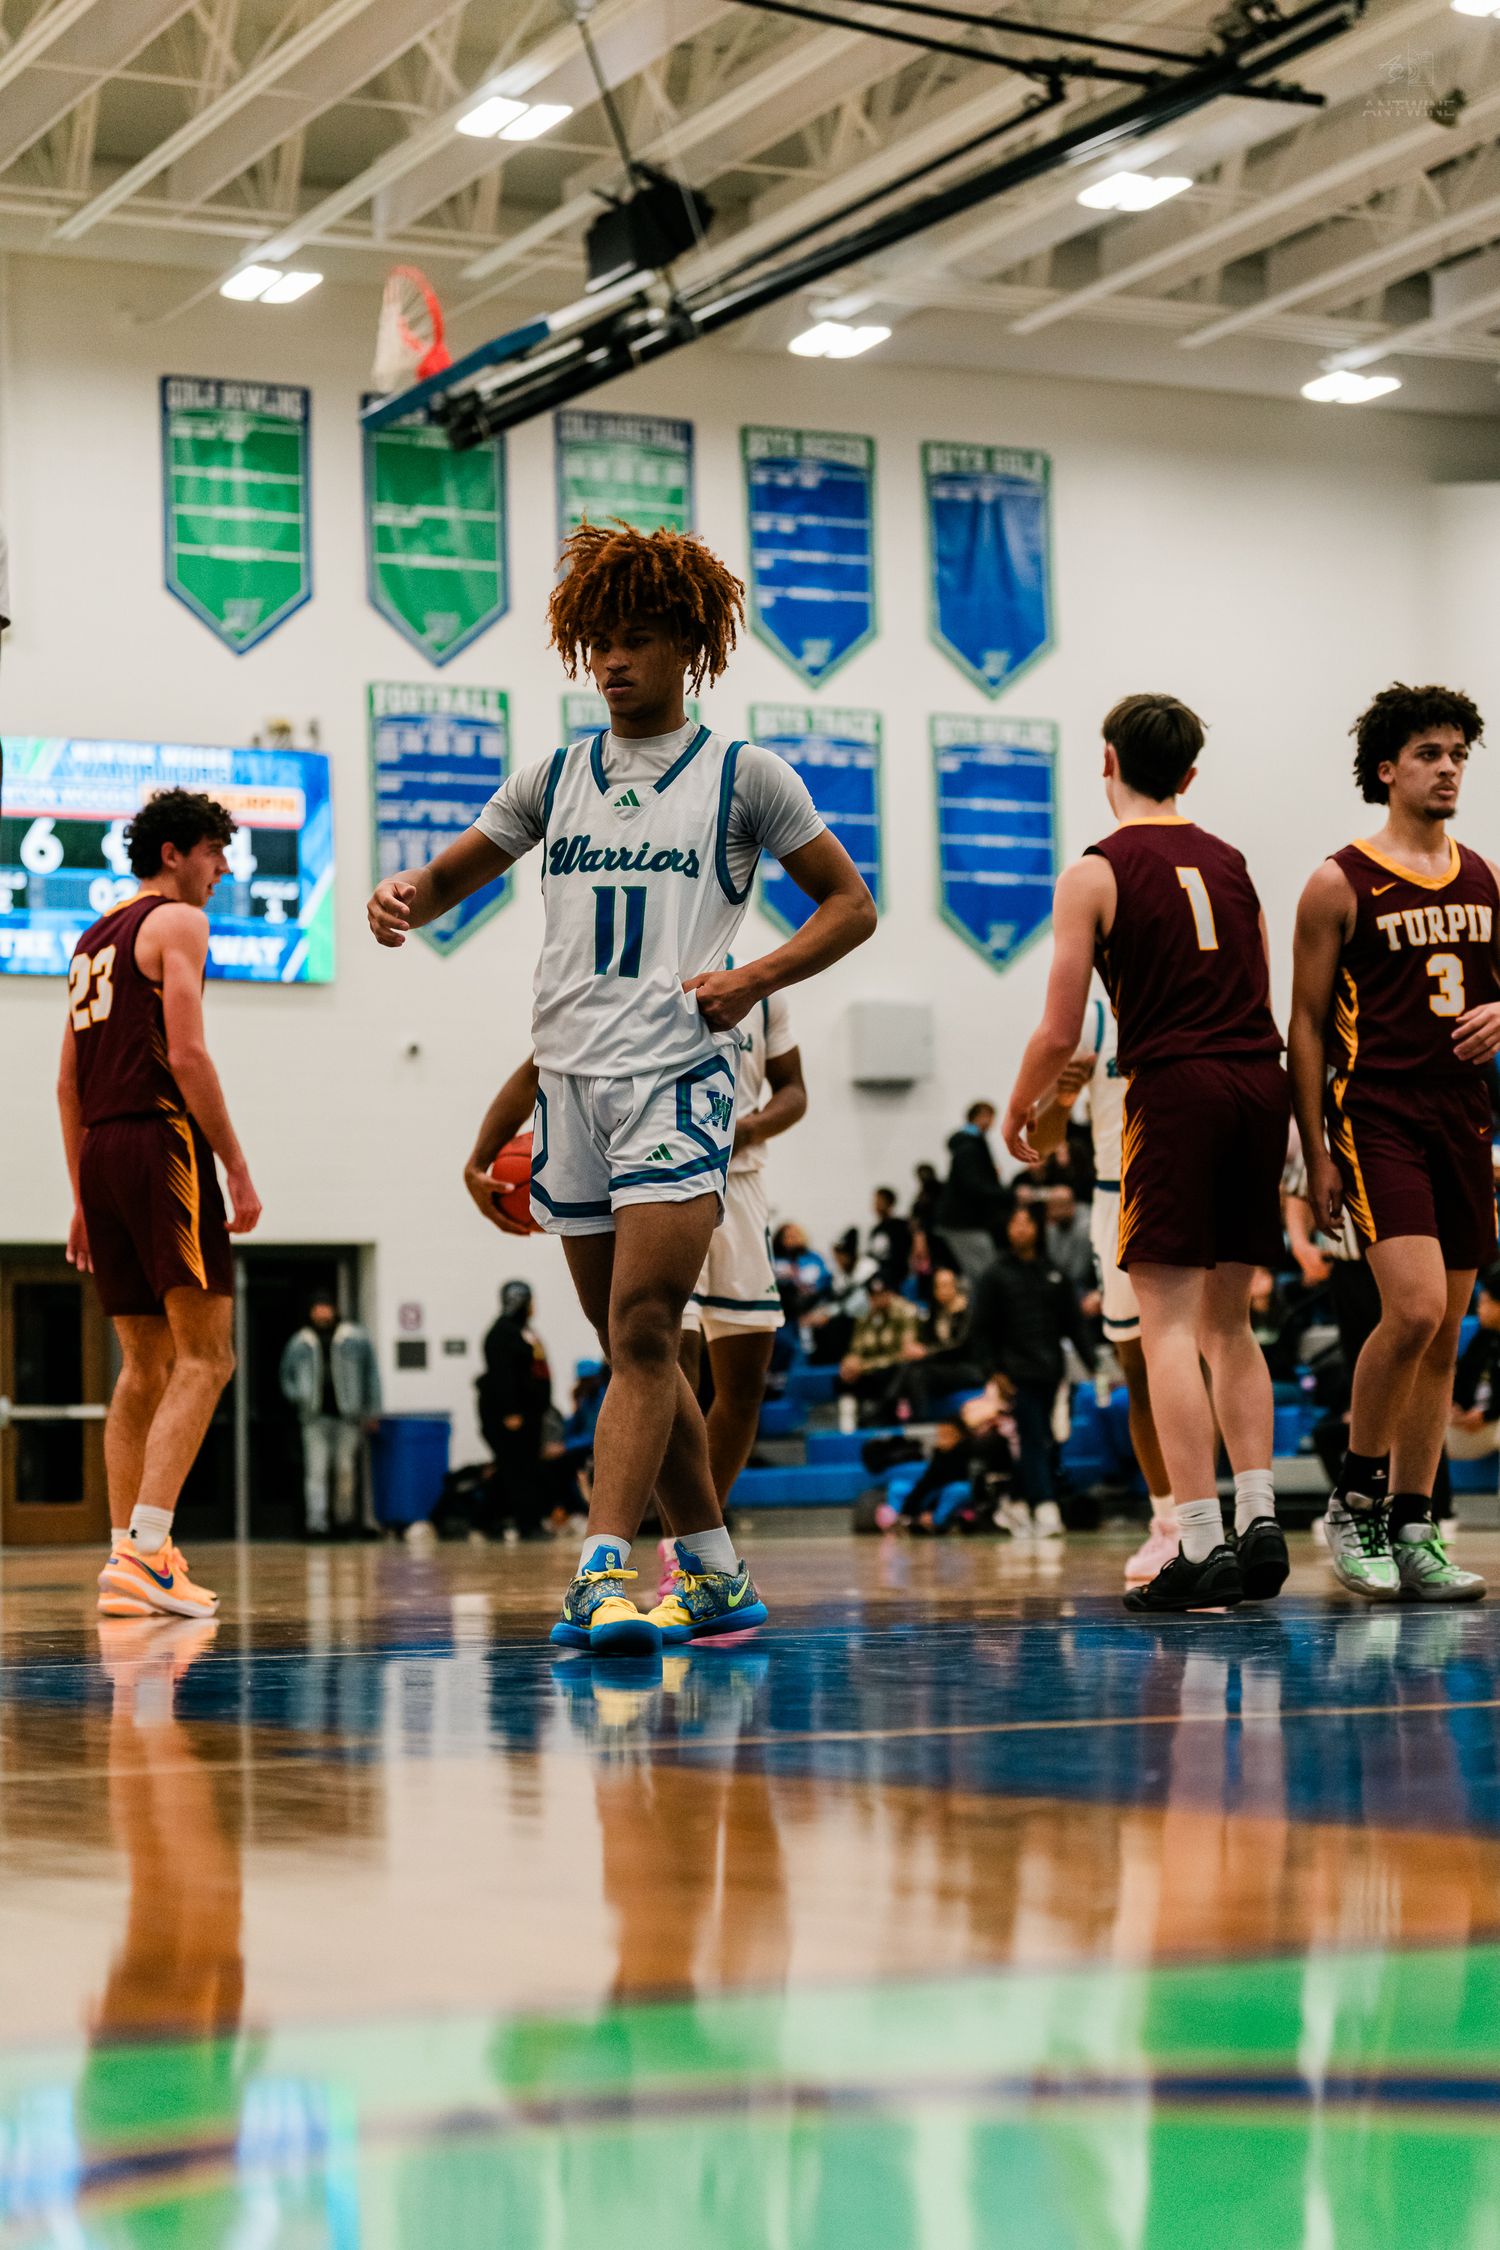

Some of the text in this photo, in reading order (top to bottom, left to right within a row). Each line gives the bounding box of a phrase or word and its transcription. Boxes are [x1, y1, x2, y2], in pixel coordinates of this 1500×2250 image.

[20, 817, 64, 875] 6
[549, 834, 700, 879] Warriors
[592, 885, 648, 979] 11
[1175, 866, 1219, 951] 1
[1376, 903, 1493, 951] TURPIN
[208, 935, 288, 968] WAY
[69, 943, 117, 1032] 23
[1425, 953, 1466, 1018] 3
